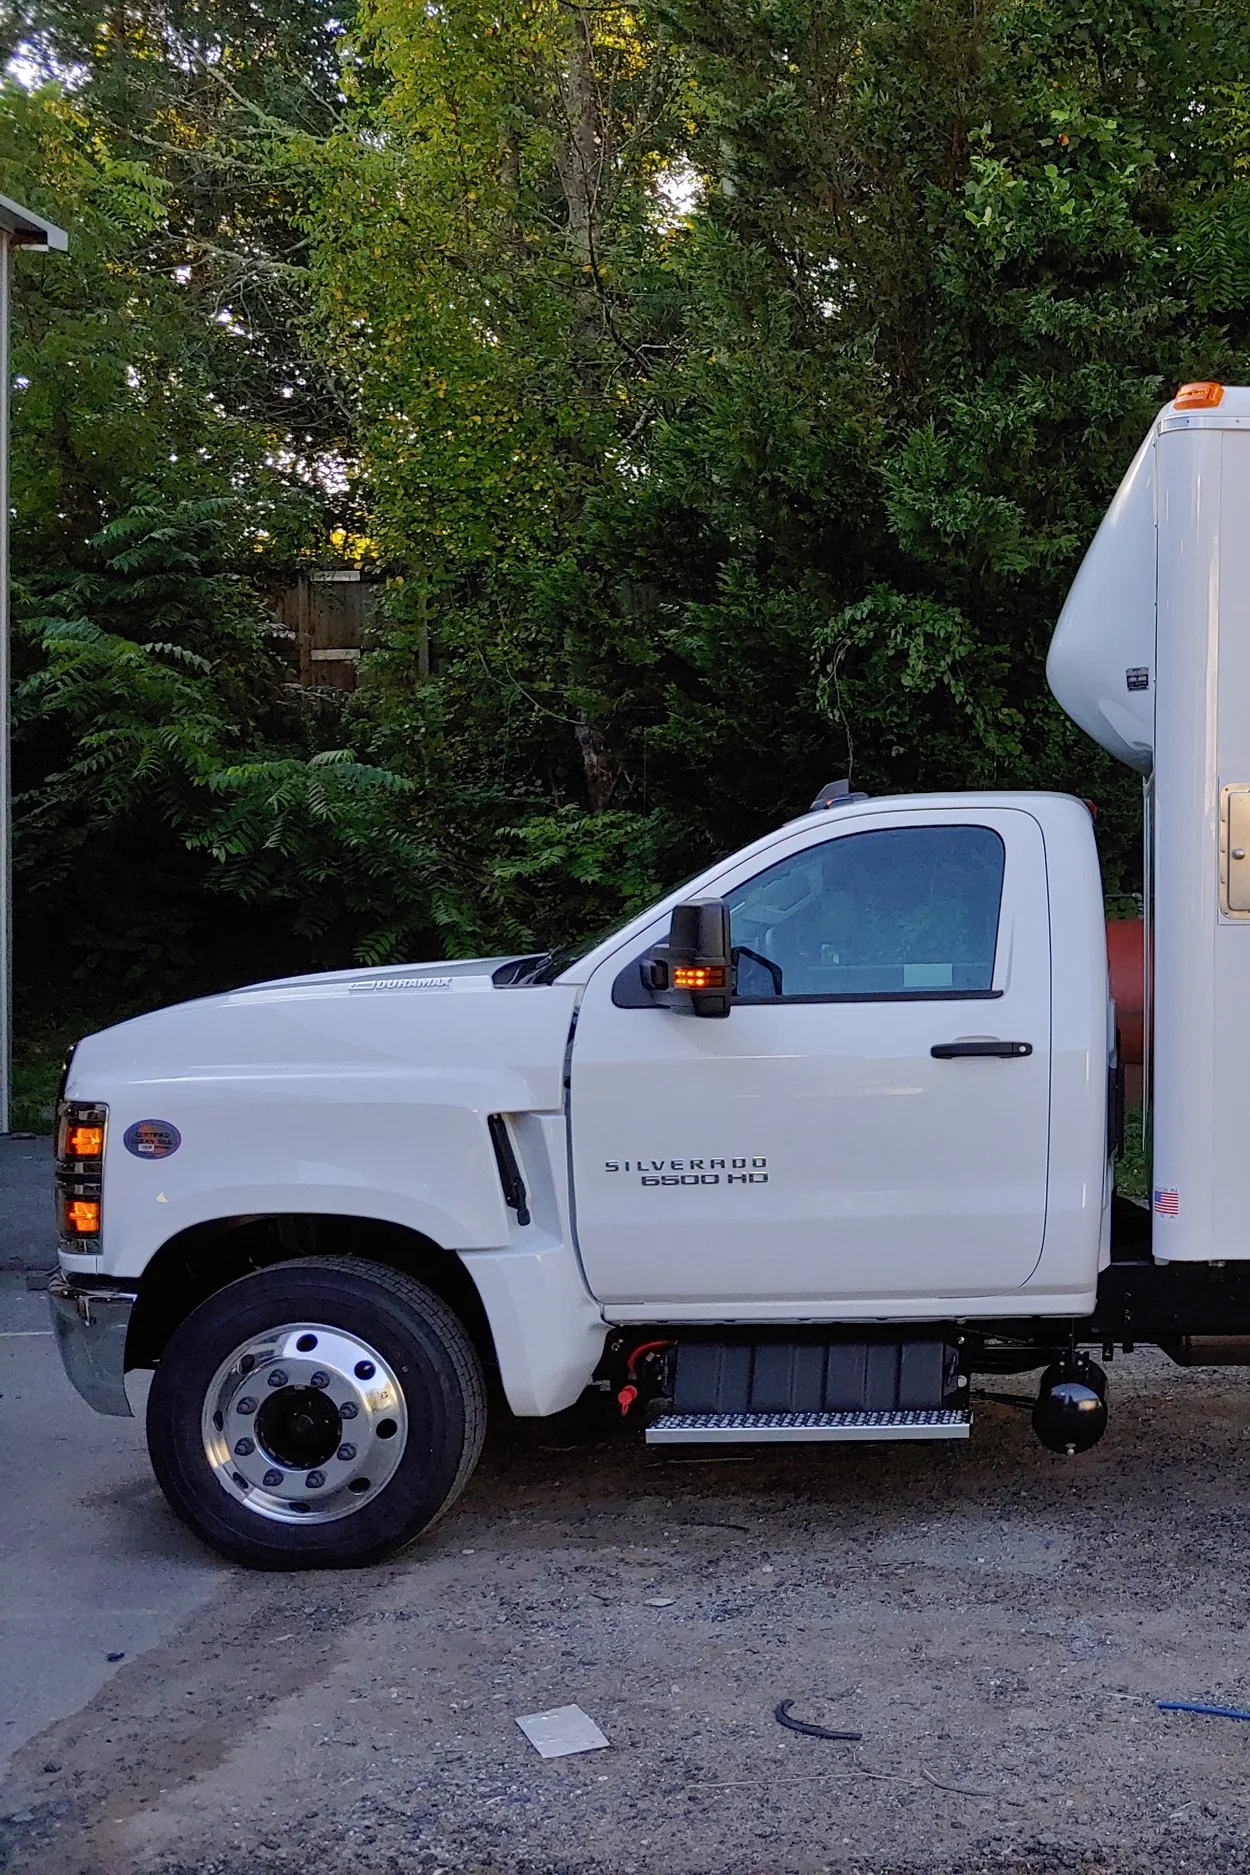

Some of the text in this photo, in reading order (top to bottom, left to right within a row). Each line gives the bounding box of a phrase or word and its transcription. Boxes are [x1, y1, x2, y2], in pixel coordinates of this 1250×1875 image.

[374, 978, 453, 990] DURAMAX
[604, 1156, 768, 1172] SILVERADO
[641, 1172, 769, 1187] 6500 HD
